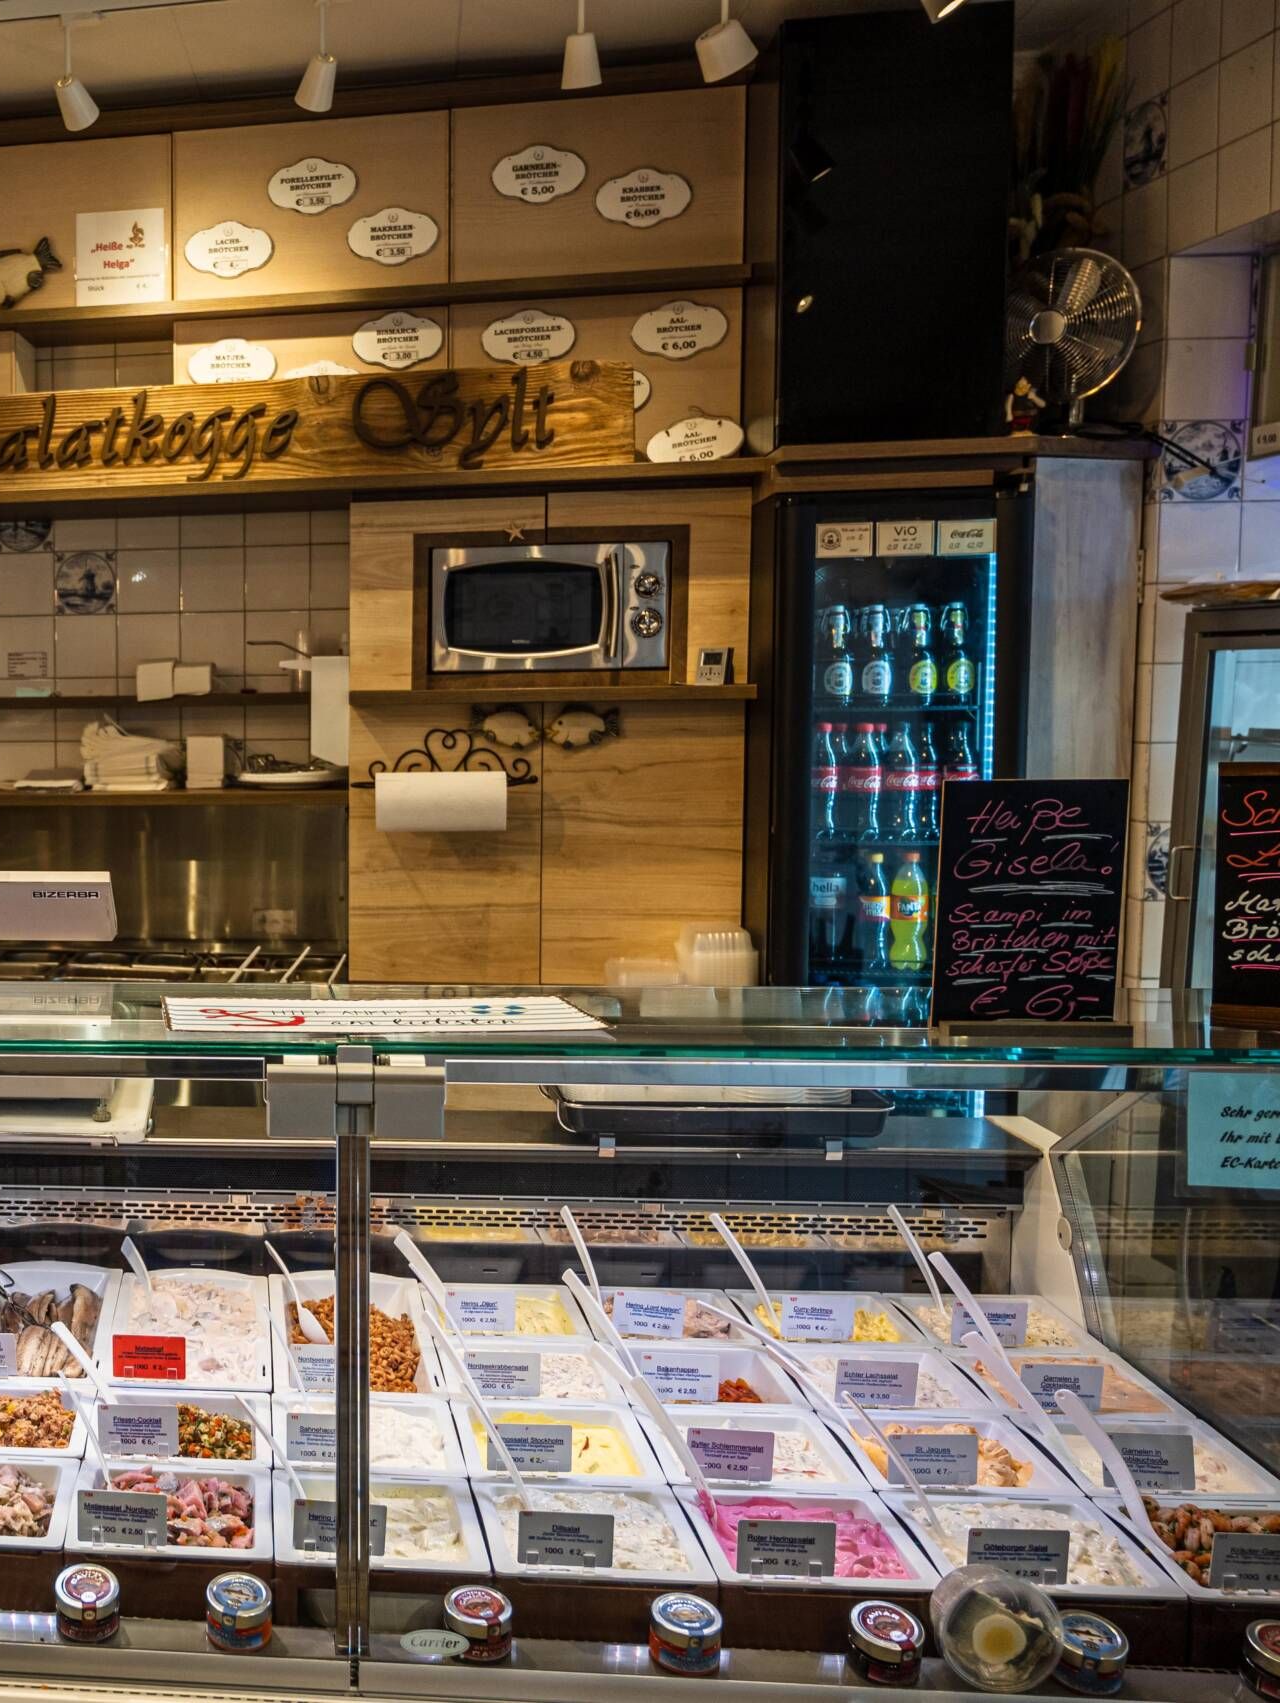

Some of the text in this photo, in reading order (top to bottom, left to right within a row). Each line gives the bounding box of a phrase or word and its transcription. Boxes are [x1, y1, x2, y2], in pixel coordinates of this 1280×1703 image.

[512, 162, 561, 173] GARNELEN-
[280, 174, 344, 185] FORELLENFILET-
[515, 170, 559, 180] BRÖTCHEN
[290, 182, 332, 191] BRÖTCHEN
[521, 185, 555, 195] € 5,00
[622, 184, 664, 194] KRABBEN-
[296, 198, 303, 206] €
[620, 193, 665, 203] BRÖTCHEN
[625, 208, 660, 219] € 6,00
[370, 224, 415, 233] MAKRELEN-
[215, 238, 243, 246] LACHS-
[370, 233, 413, 241] BRÖTCHEN
[208, 246, 249, 254] BRÖTCHEN
[376, 247, 406, 257] € 3,50
[669, 317, 689, 325] AAL-
[376, 328, 419, 336] BISMARCK-
[494, 325, 564, 336] LACHSFORELLEN-
[657, 324, 702, 334] BRÖTCHEN
[376, 335, 419, 344] BRÖTCHEN
[507, 334, 551, 343] BRÖTCHEN
[672, 340, 697, 350] 6,00
[526, 350, 543, 359] 4,50
[353, 365, 555, 471] Sylt
[683, 431, 703, 439] AAL-
[672, 436, 717, 448] BRÖTCHEN
[894, 526, 918, 536] ViO
[812, 877, 839, 893] hella
[32, 889, 100, 899] BIZERBA
[949, 900, 1092, 931] Scampi im
[952, 926, 1116, 952] Brötchen mit
[1042, 951, 1115, 974] Soße
[970, 985, 1010, 1016] €
[1220, 1105, 1252, 1119] Sehr
[1220, 1130, 1272, 1143] Ihr mit
[625, 1301, 644, 1310] Hering
[793, 1305, 833, 1315] Curry-Shrimps
[656, 1365, 699, 1373] Balkanhappen
[844, 1371, 899, 1380] Echter Lachssalat
[1043, 1374, 1072, 1383] Garnelen
[112, 1416, 162, 1425] Friesen-Cocktail
[530, 1437, 565, 1446] Stockholm
[691, 1440, 764, 1453] Sylter Schlemmersalat
[1121, 1447, 1153, 1457] Garnelen
[733, 1463, 748, 1471] 2,50
[83, 1502, 122, 1512] Matjessalat
[308, 1513, 332, 1523] Hering
[128, 1528, 144, 1536] 2,50
[551, 1524, 581, 1534] Dillsalat
[747, 1533, 816, 1545] Roter Heringssalat
[544, 1547, 564, 1555] 100G
[983, 1542, 1048, 1554] Göteborger Salat
[70, 1571, 105, 1585] CAVIAR
[1022, 1569, 1040, 1578] 2,50
[866, 1610, 901, 1625] CAVIAR
[410, 1636, 461, 1649] Carrier
